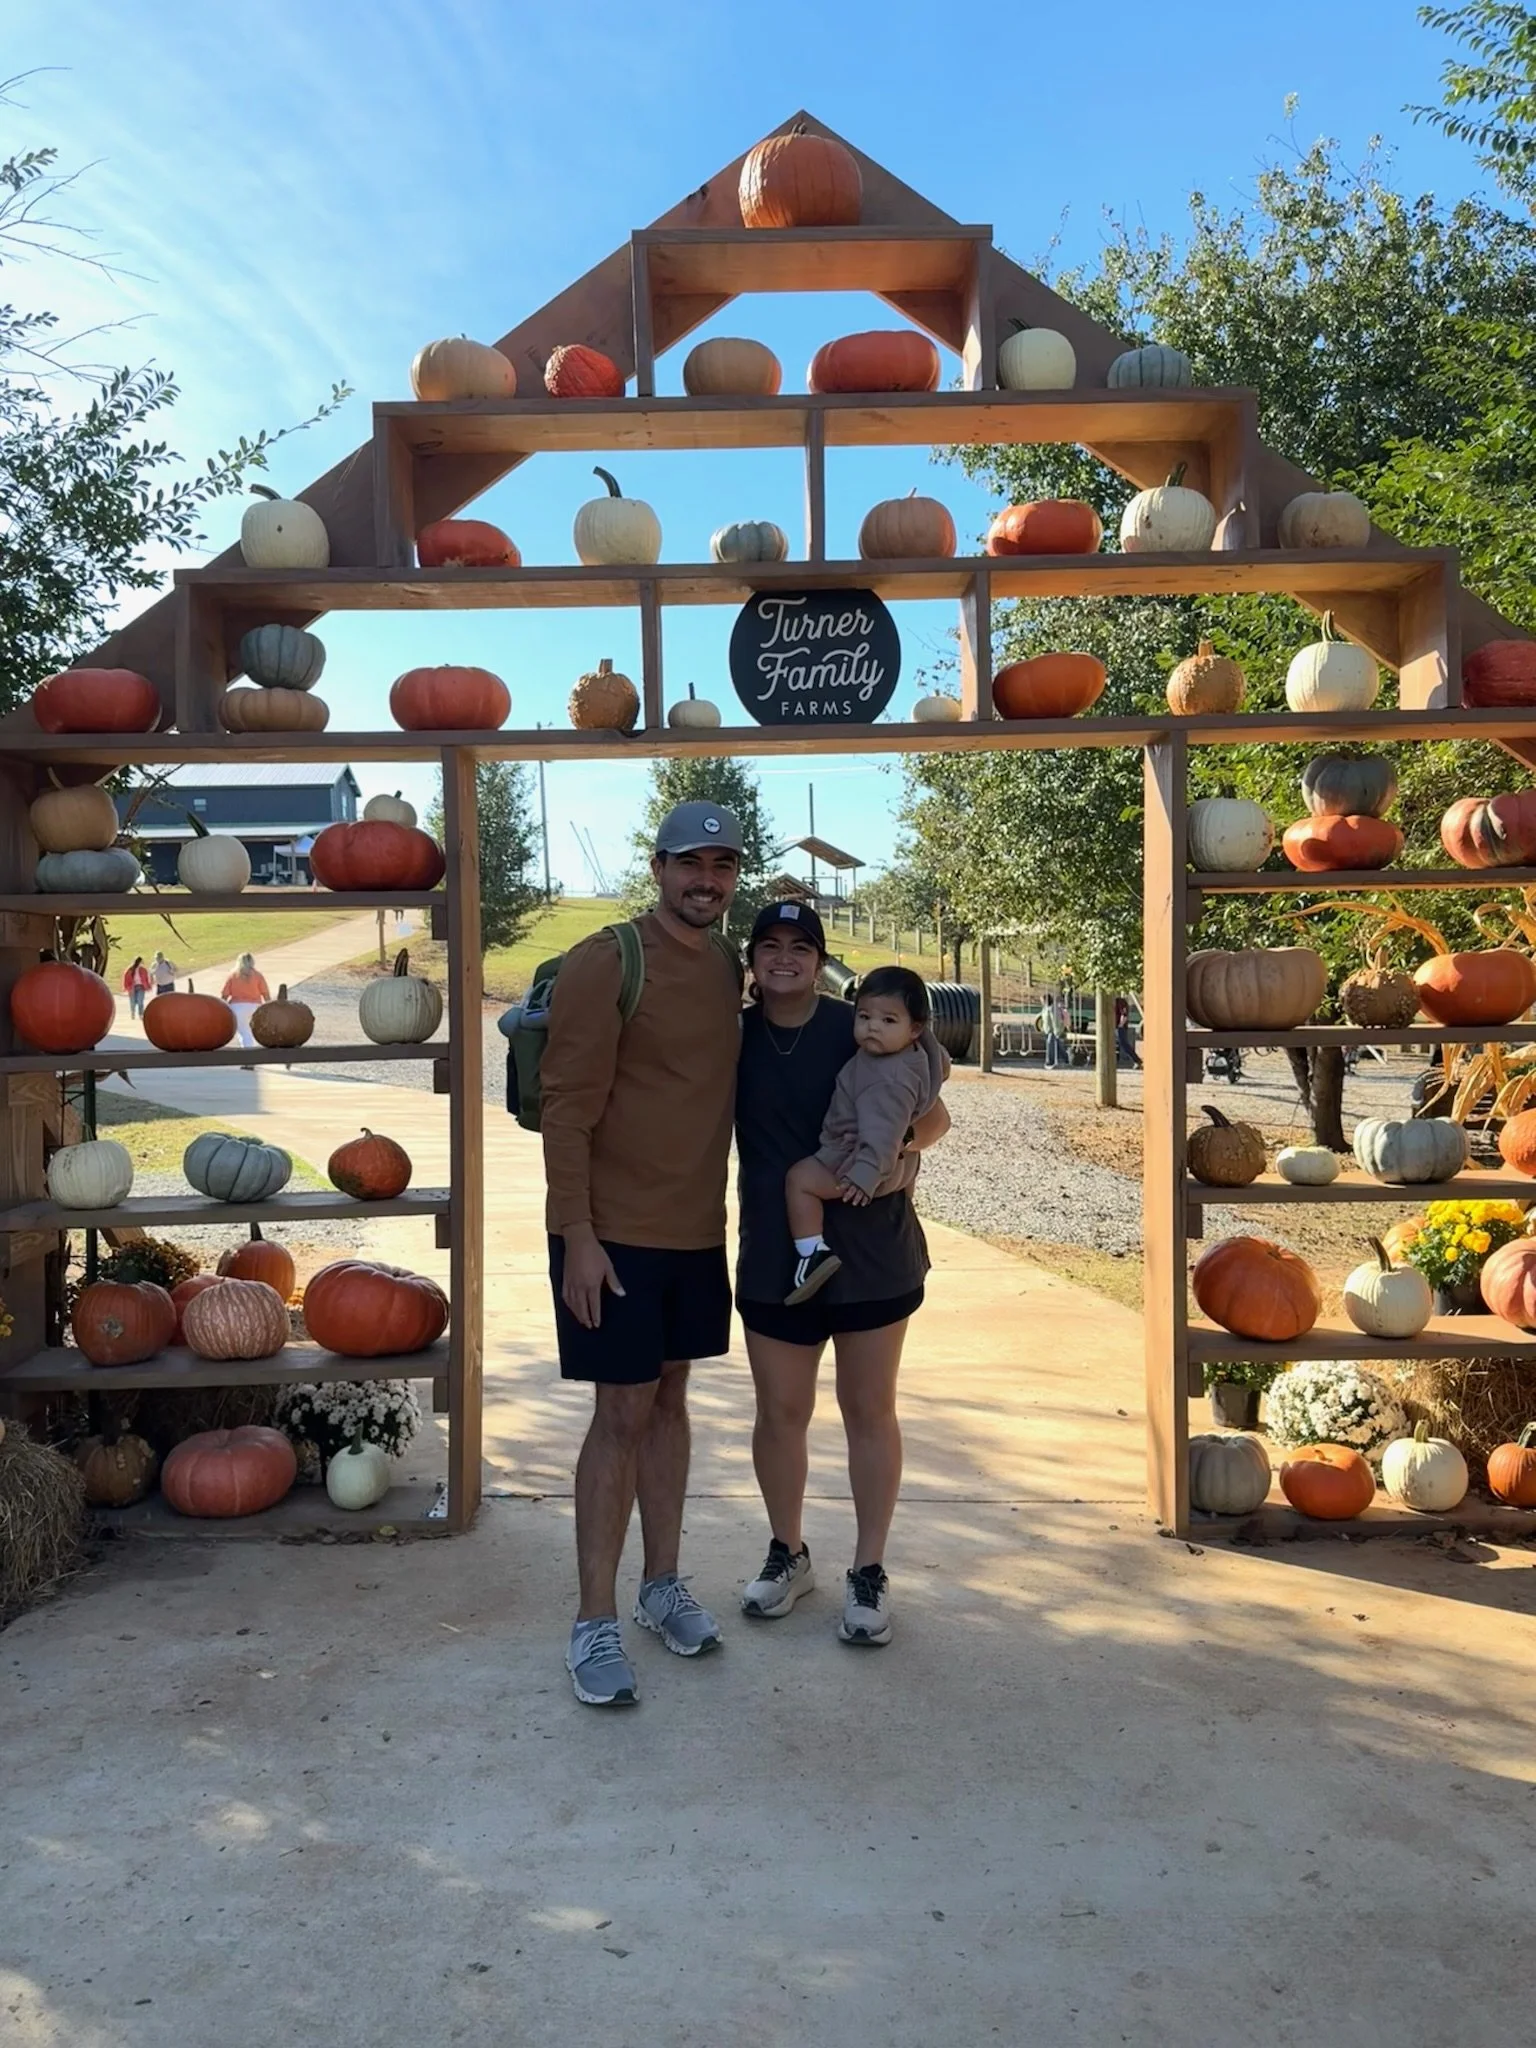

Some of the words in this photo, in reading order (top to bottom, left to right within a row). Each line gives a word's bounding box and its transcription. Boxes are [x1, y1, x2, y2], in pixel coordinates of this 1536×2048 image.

[758, 597, 875, 648] Turner
[757, 642, 885, 701] Family
[781, 700, 852, 716] FARMS
